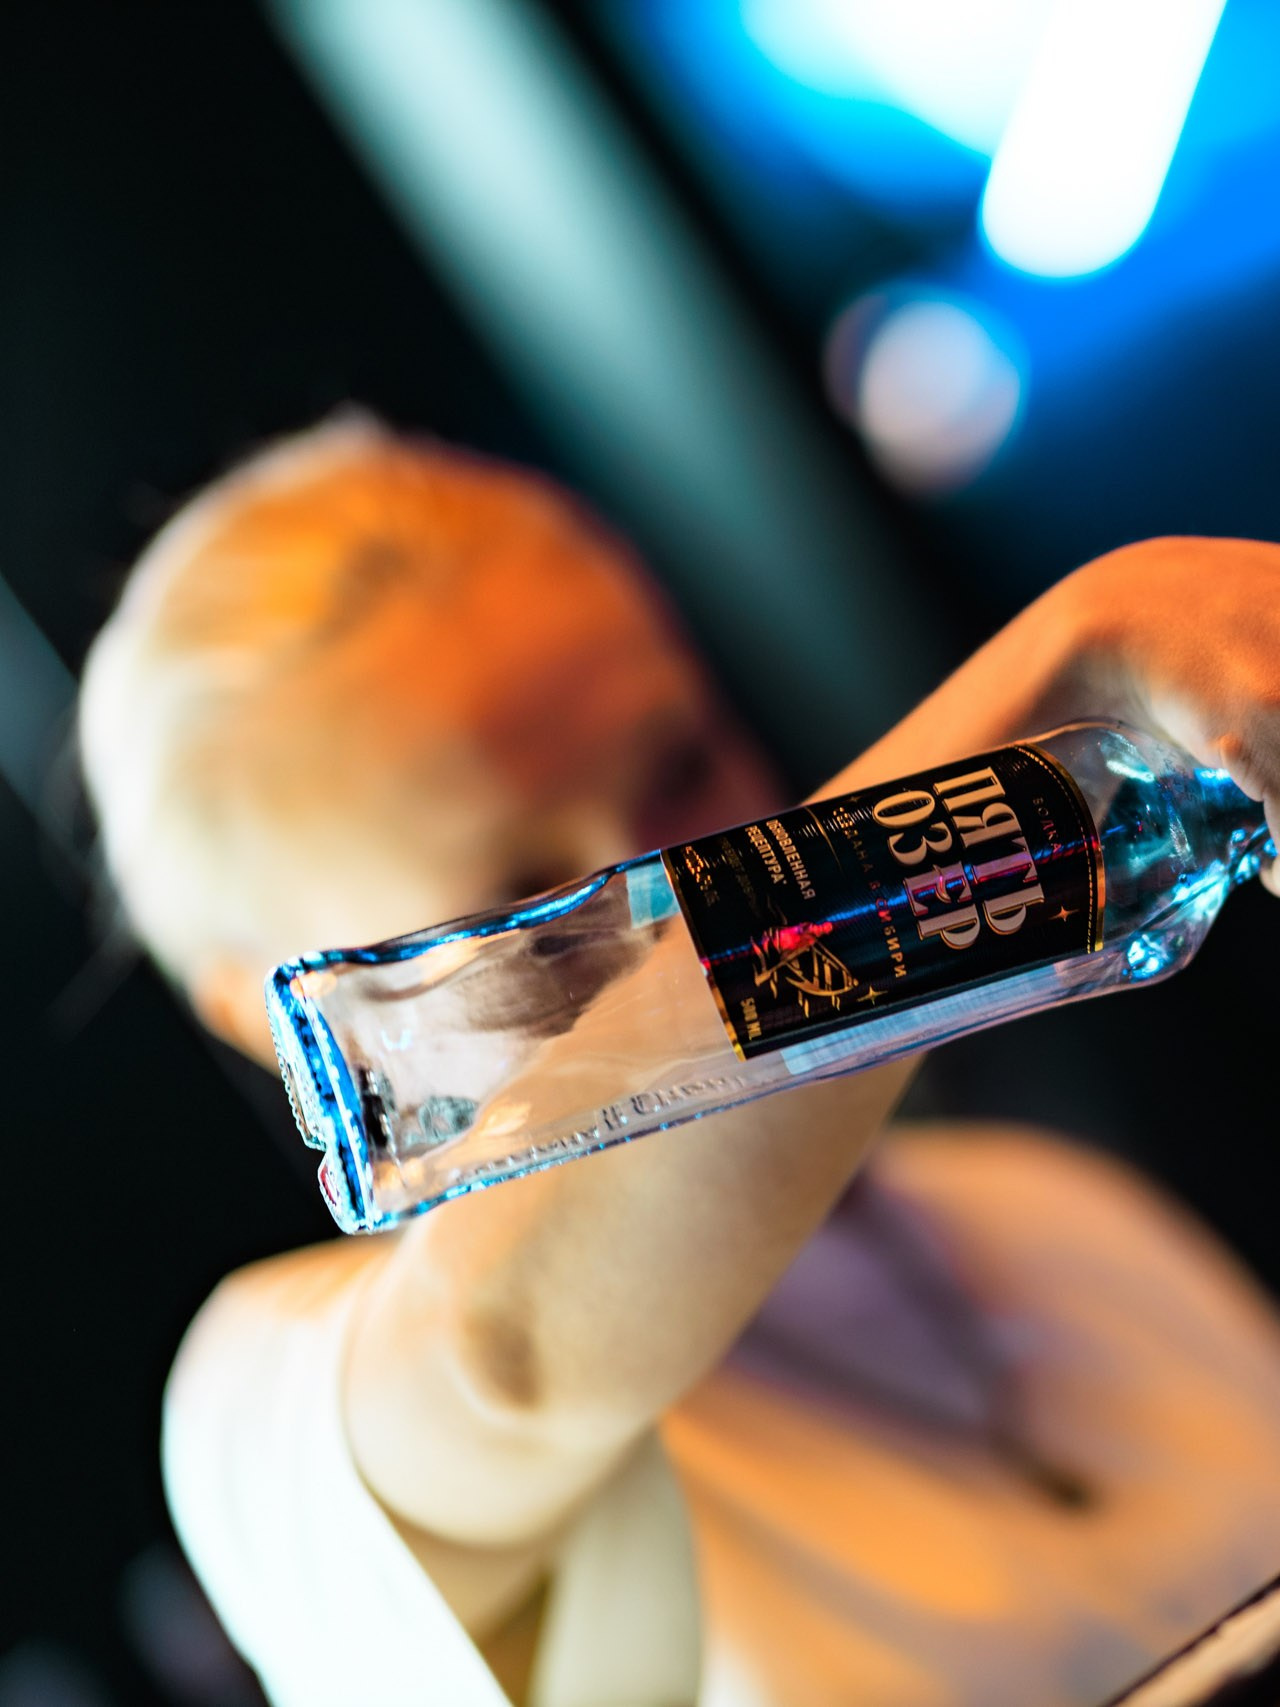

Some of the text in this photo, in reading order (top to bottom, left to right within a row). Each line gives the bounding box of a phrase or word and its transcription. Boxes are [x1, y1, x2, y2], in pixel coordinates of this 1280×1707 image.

[765, 817, 816, 899] ОБНОВЛЕННАЯ
[872, 789, 982, 950] ОЗЕР
[933, 766, 1045, 936] ПЯТЬ
